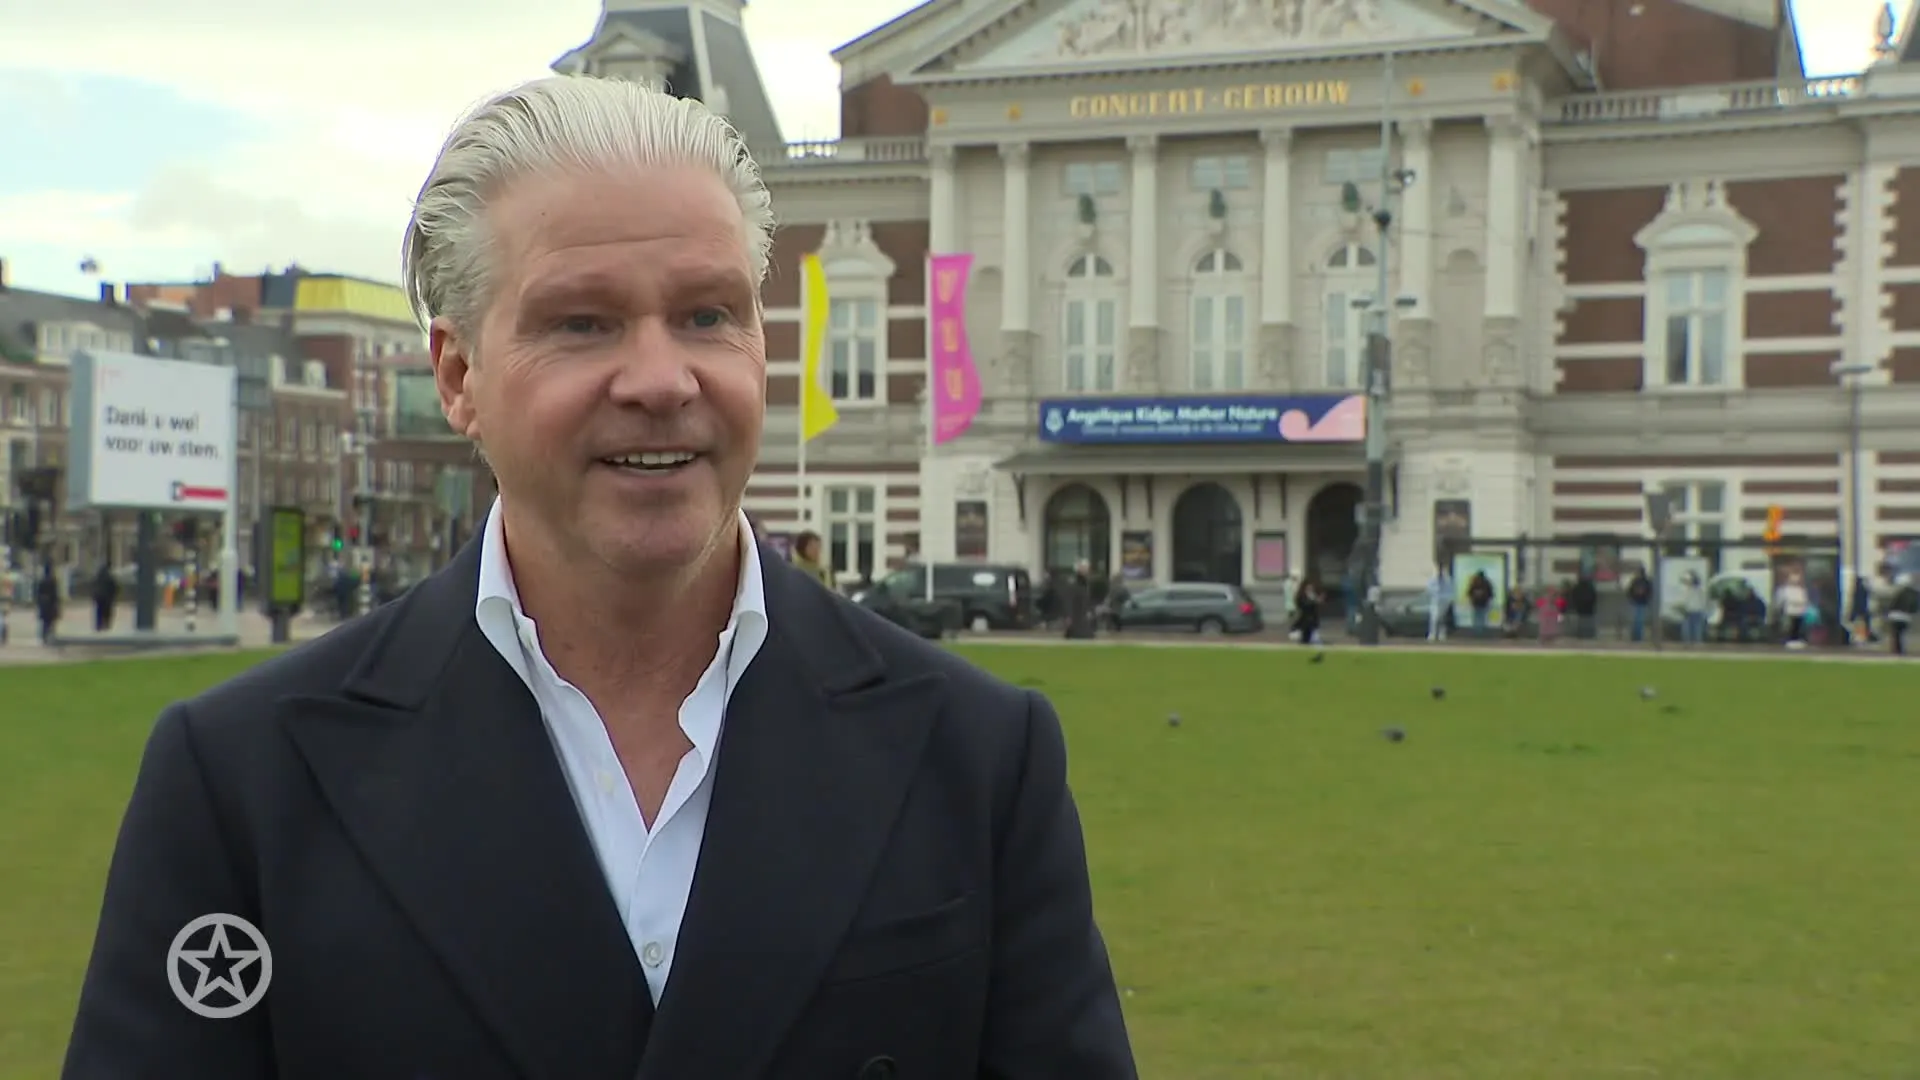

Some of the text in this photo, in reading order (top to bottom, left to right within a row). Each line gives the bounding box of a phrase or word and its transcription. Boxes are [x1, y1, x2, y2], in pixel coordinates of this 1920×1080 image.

[1223, 80, 1349, 109] GEBOUW
[105, 405, 200, 432] Dank u wel
[1066, 407, 1133, 426] Angelique
[1178, 405, 1226, 420] Mother
[1228, 405, 1278, 420] Nature
[105, 435, 143, 452] voor
[149, 439, 173, 455] uw
